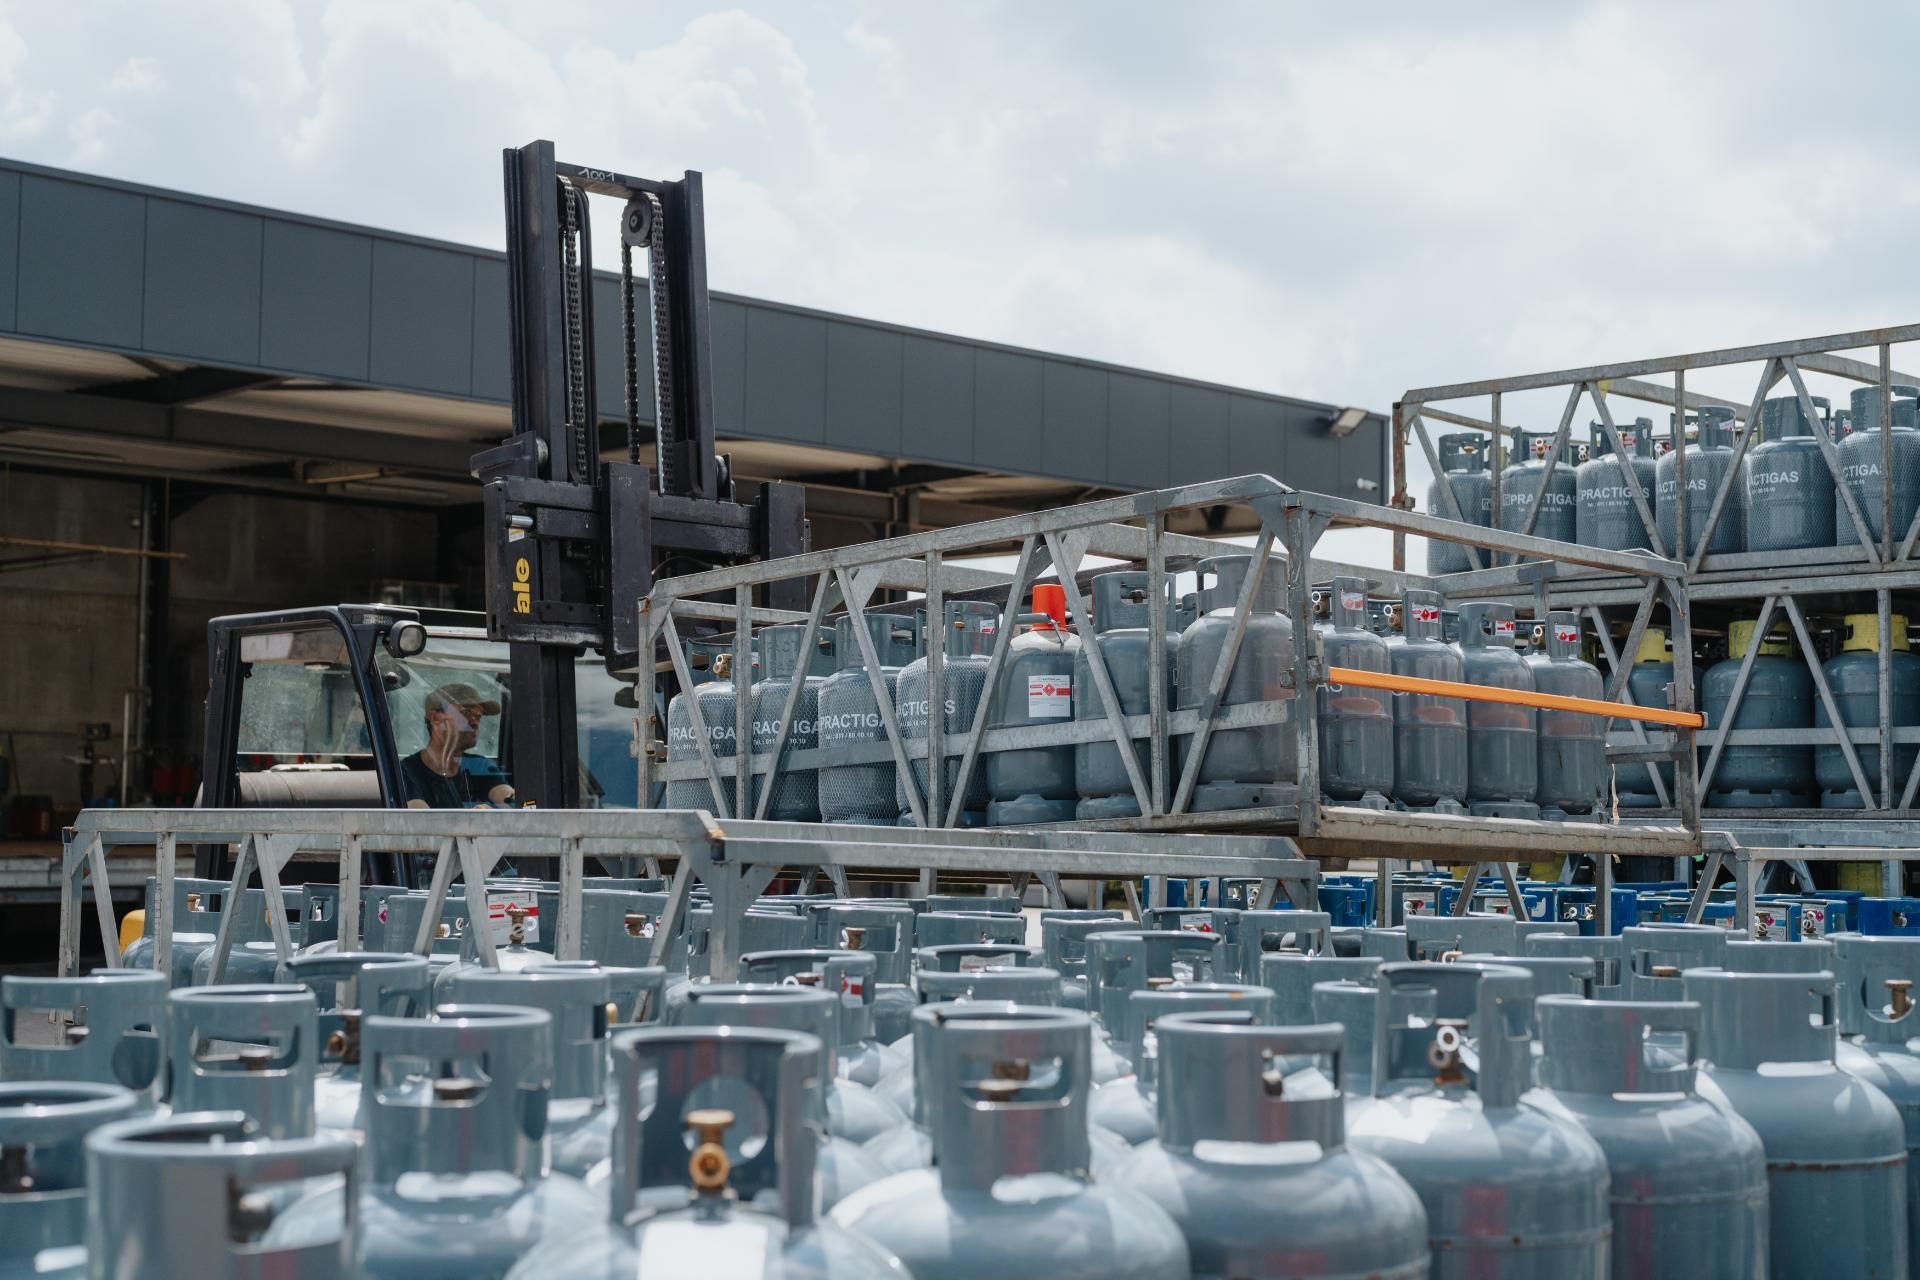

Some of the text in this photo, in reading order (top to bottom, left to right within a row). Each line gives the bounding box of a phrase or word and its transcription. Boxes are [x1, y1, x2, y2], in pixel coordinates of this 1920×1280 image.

[577, 167, 615, 183] 1001
[1581, 486, 1650, 500] PRACTIGS
[819, 713, 886, 730] PRACTIG
